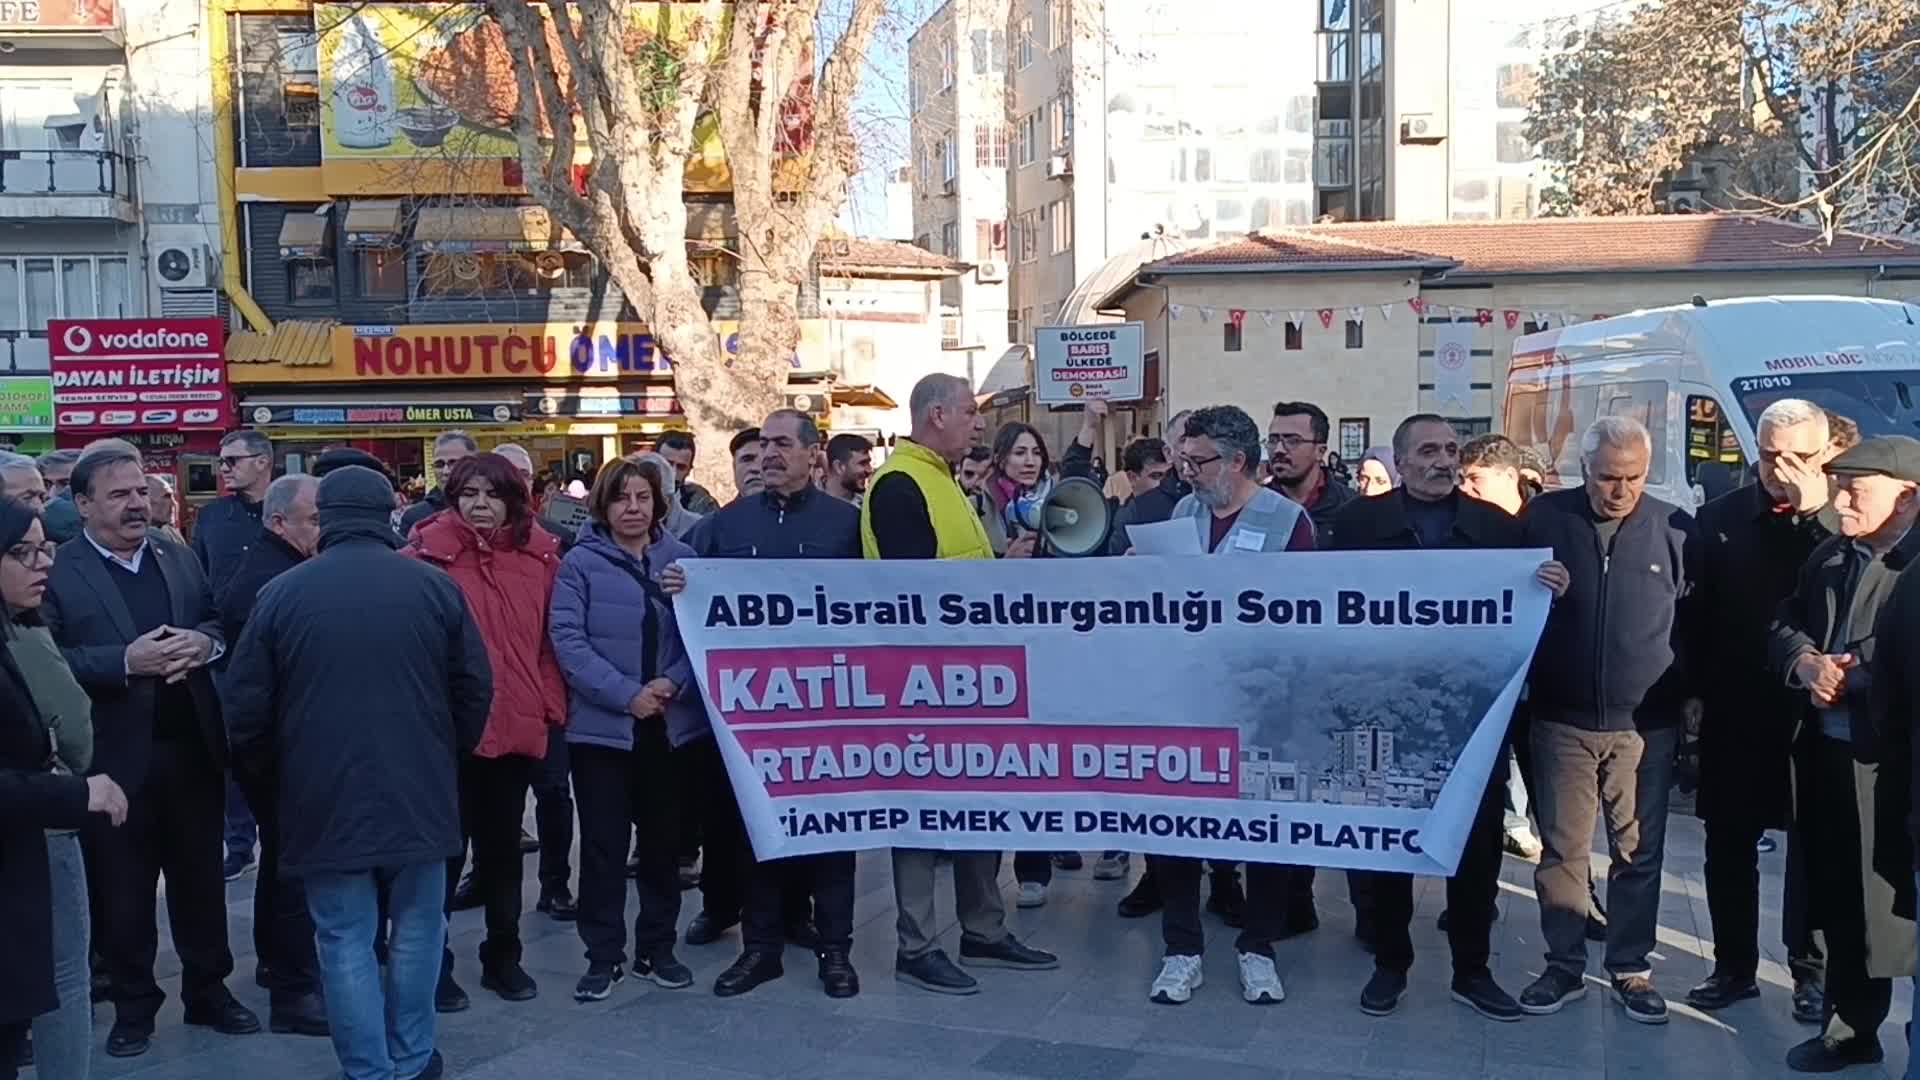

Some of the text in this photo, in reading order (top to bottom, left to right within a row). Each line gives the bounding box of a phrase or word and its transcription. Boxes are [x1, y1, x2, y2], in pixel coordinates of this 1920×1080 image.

[99, 328, 209, 349] vodafone
[1060, 331, 1117, 341] BÖLGEDE
[354, 335, 557, 376] NOHUTCU
[1070, 344, 1108, 356] BARIŞ
[1066, 357, 1112, 367] ÜLKEDE
[54, 364, 220, 389] DAYAN İLETİŞİM
[1053, 367, 1127, 380] DEMOKRASİ!
[1740, 375, 1792, 391] 27/010
[407, 406, 440, 421] ÖMER
[444, 407, 473, 421] USTA
[705, 585, 1514, 633] ABD-İsrail Saldırganlığı Son Bulsun!
[718, 654, 1018, 713] KATİL ABD
[752, 733, 1231, 784] RTADOĞUDAN DEFOL!
[920, 809, 1012, 833] EMEK
[1020, 810, 1064, 833] VE
[1075, 810, 1279, 844] DEMOKRASİ
